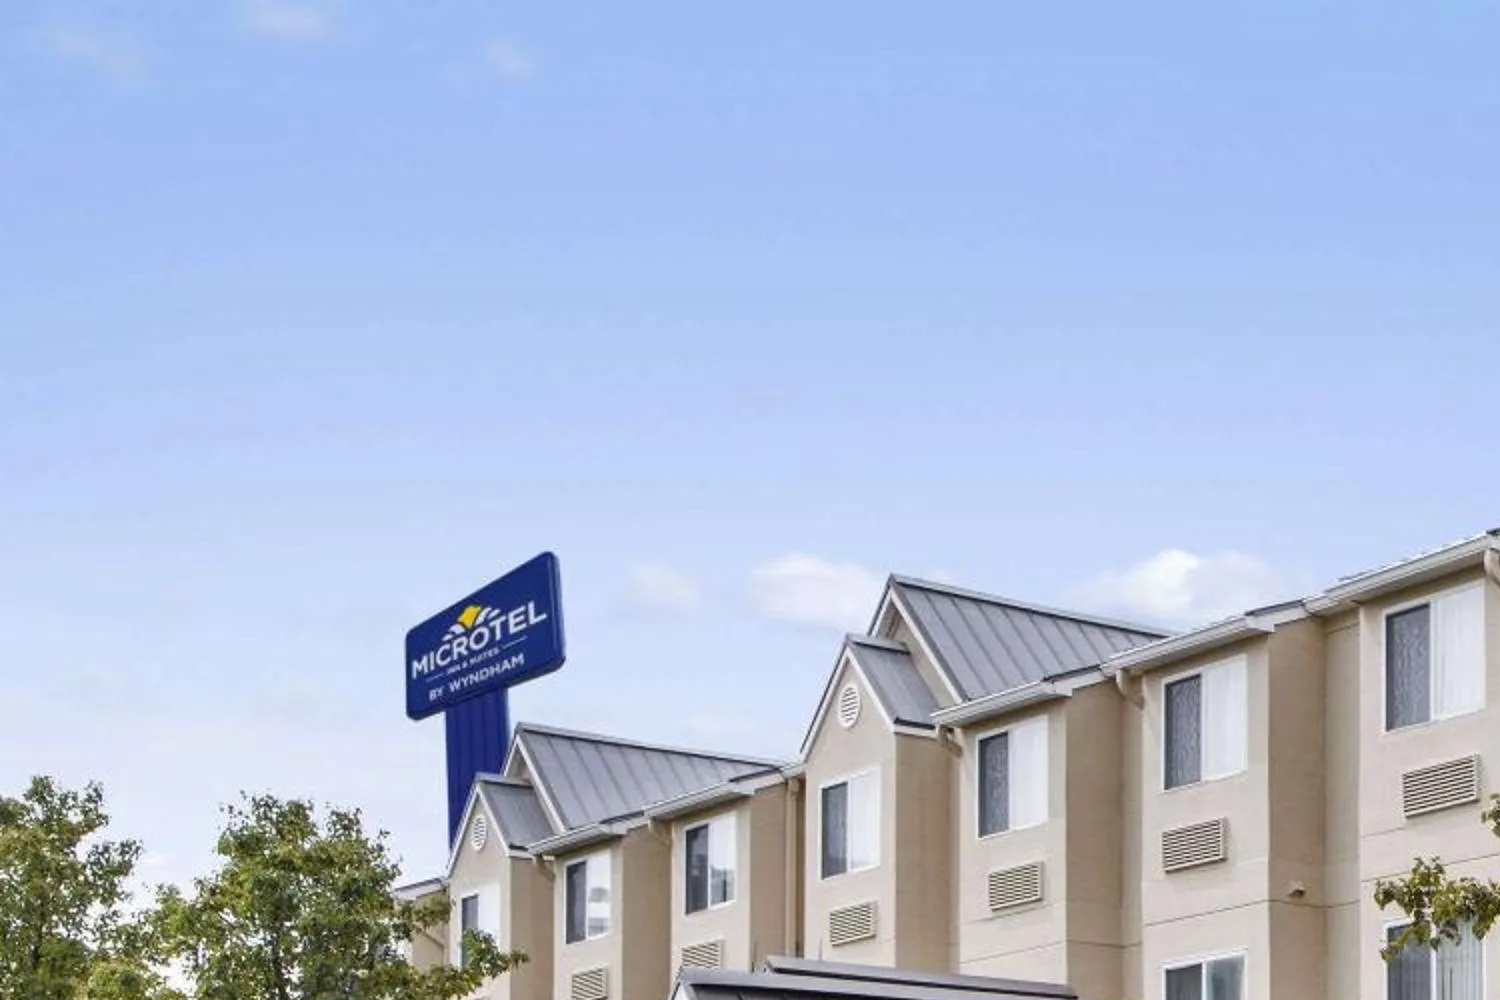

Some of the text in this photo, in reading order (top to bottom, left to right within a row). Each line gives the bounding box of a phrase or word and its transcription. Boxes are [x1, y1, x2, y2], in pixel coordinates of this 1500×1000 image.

[411, 601, 547, 680] MICROTEL
[429, 686, 444, 701] BY
[449, 653, 525, 692] WYNDHAM
